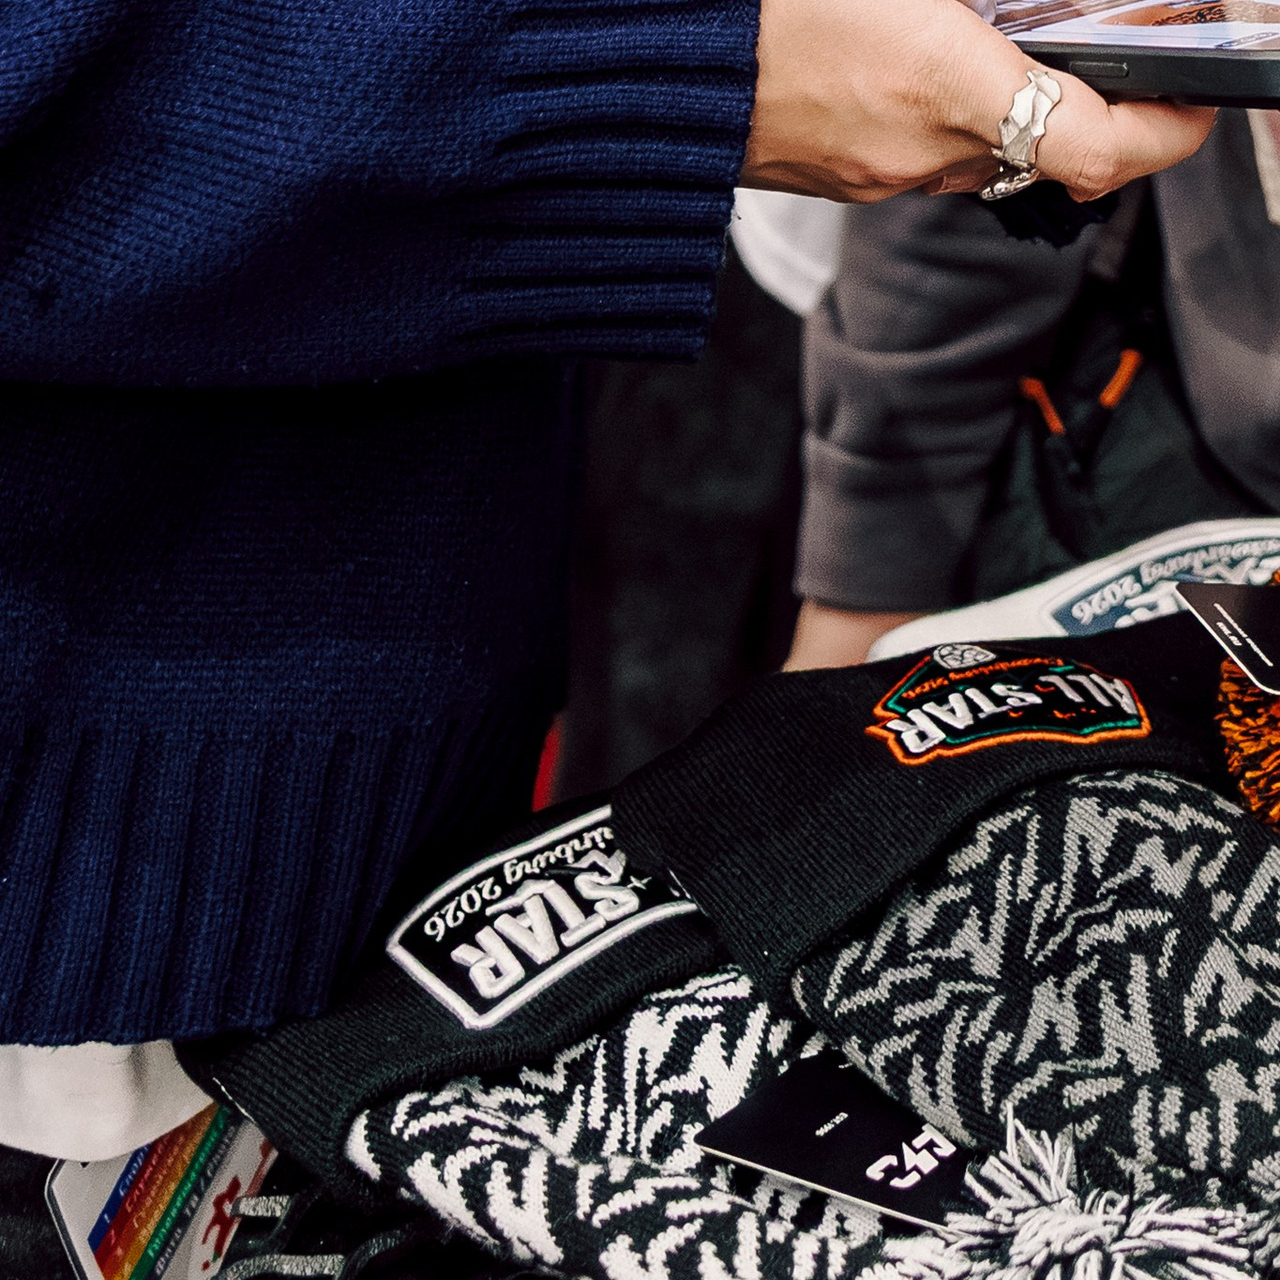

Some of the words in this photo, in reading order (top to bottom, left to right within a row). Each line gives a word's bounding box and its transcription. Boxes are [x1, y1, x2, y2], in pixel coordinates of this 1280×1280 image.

[1071, 574, 1142, 625] 2026
[886, 682, 1044, 754] STAR
[1039, 673, 1138, 715] ALL
[424, 876, 503, 943] 2026
[450, 872, 640, 1000] STAR
